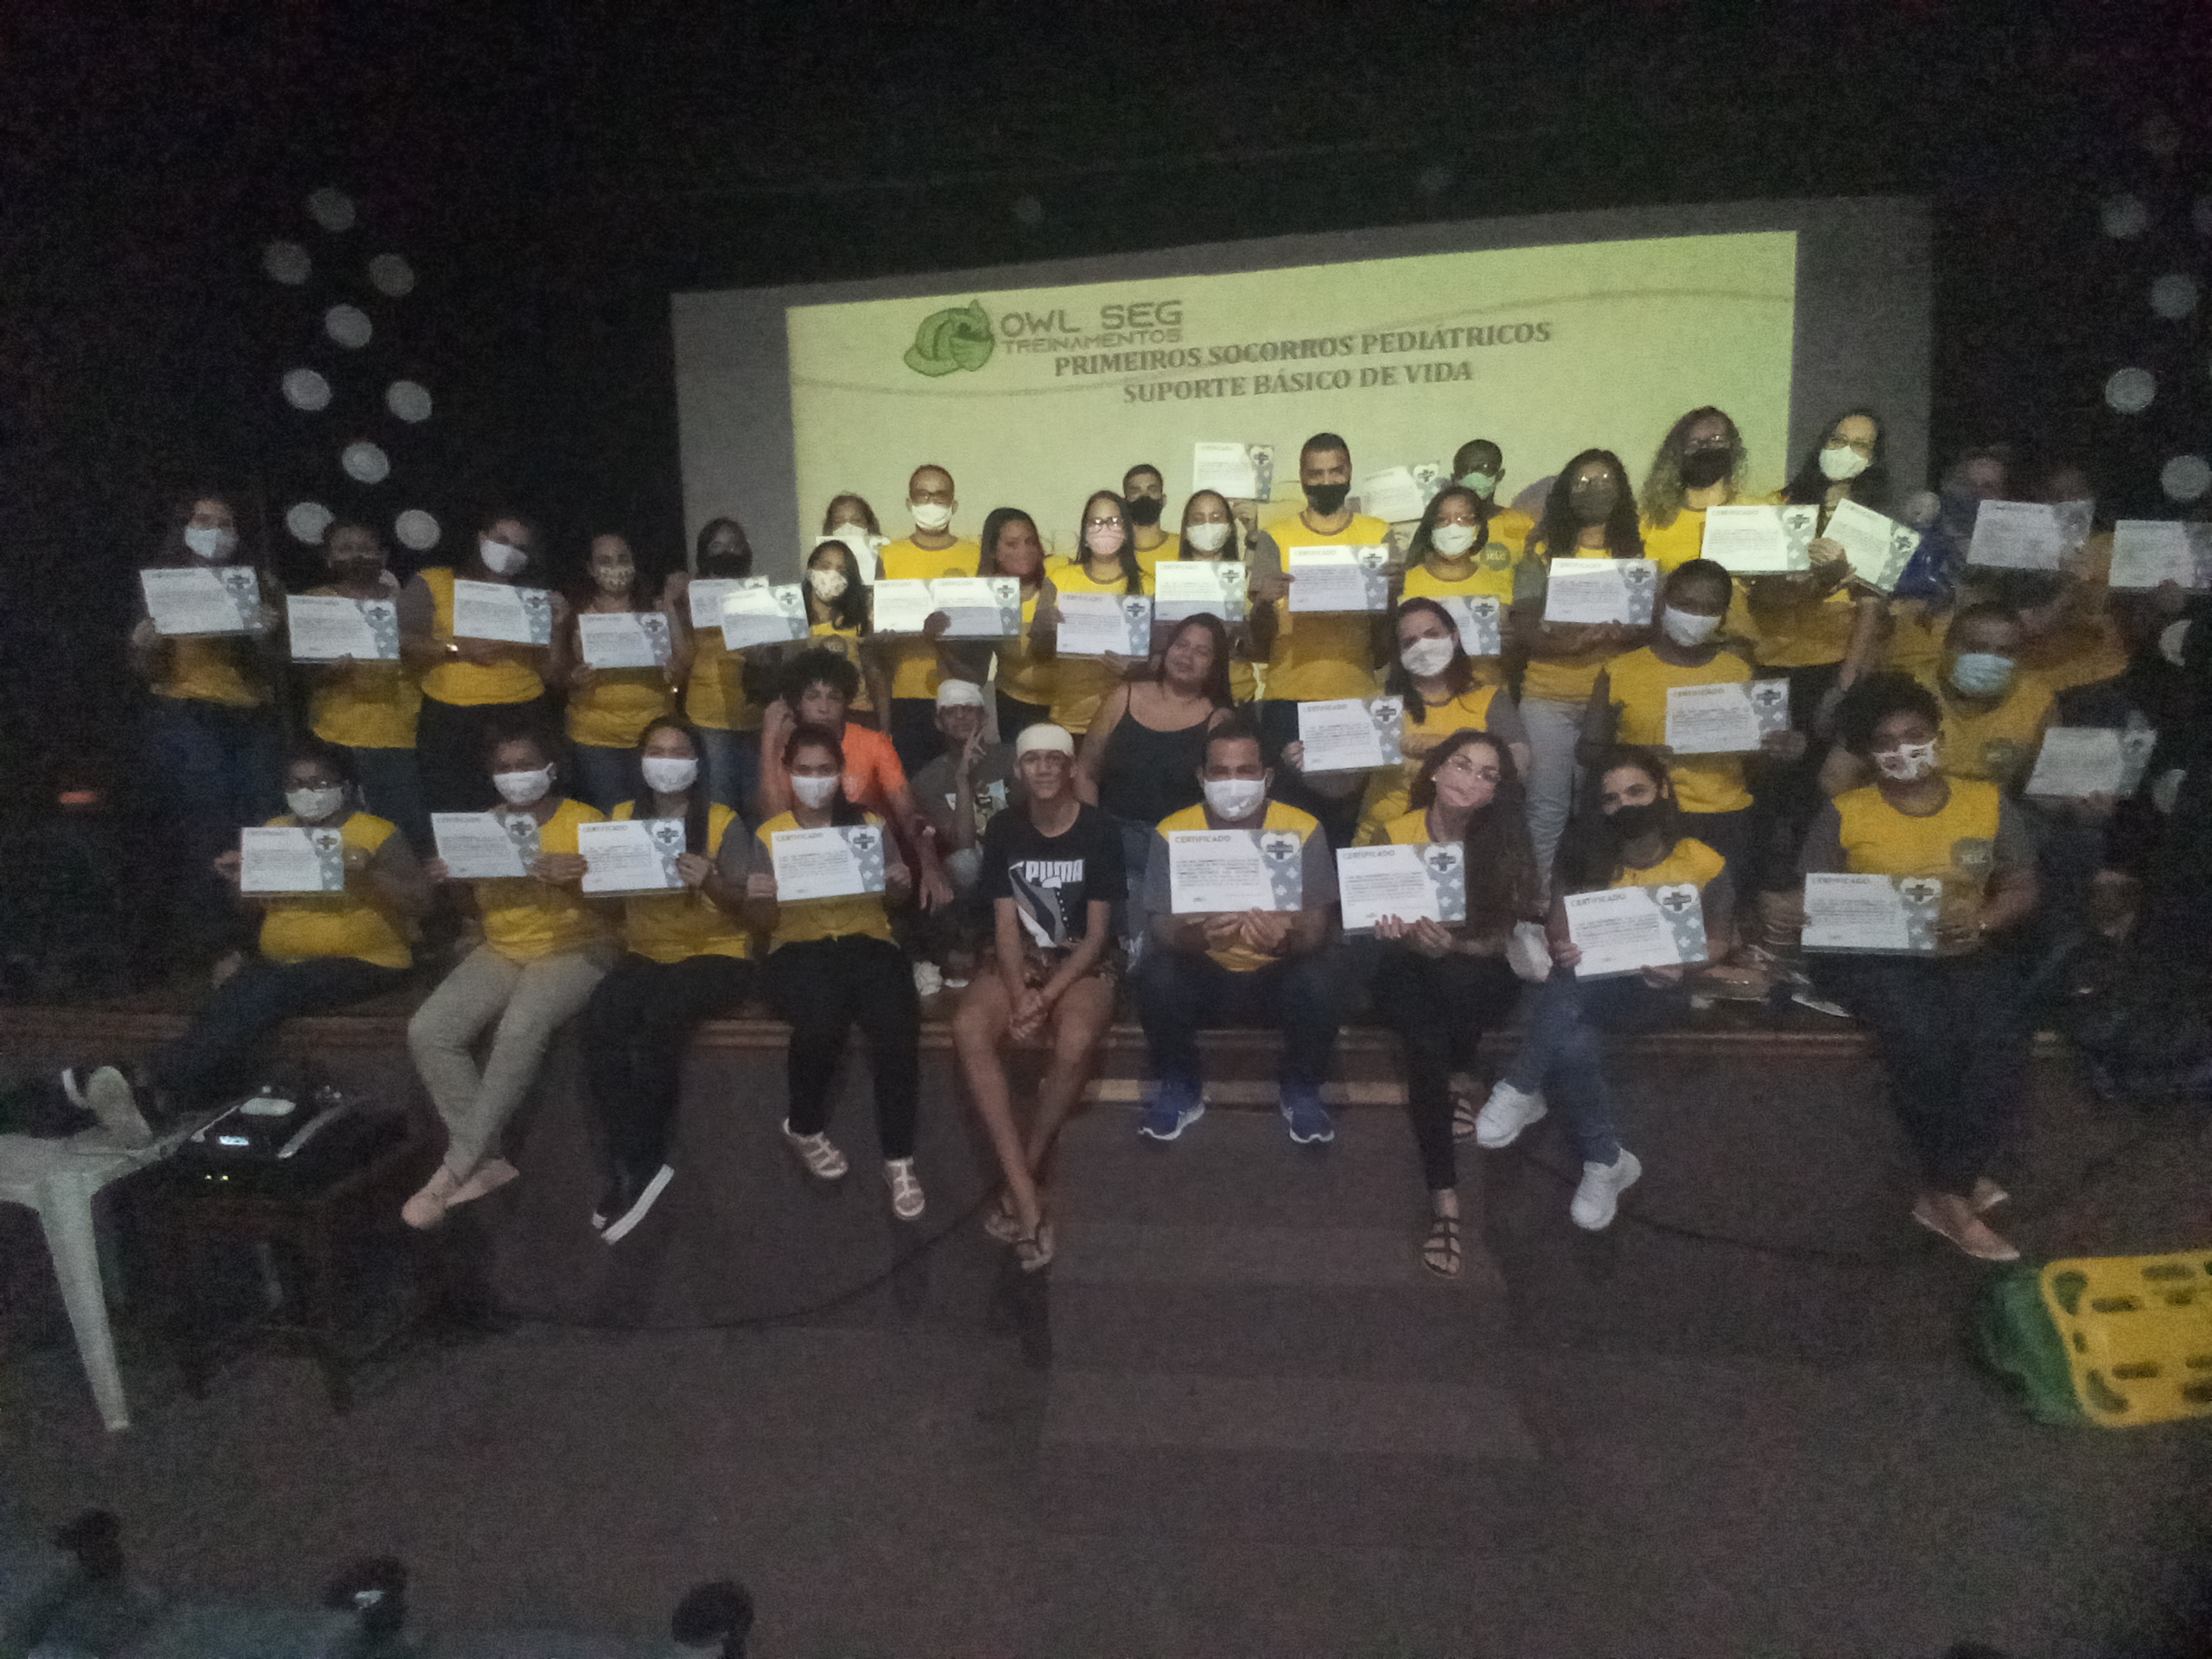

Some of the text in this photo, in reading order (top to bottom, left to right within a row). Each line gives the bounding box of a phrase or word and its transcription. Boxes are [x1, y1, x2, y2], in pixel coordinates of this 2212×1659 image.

[1001, 300, 1183, 337] OWL SEG
[1002, 328, 1183, 354] TREINAMENTOS
[1055, 347, 1202, 377] PRIMEIROS
[1209, 334, 1354, 366] SOCORROS
[1124, 360, 1473, 404] SUPORTE BÁSICO DE VIDA
[1174, 835, 1231, 843] CERTIFICADO
[1026, 859, 1084, 883] PUMA
